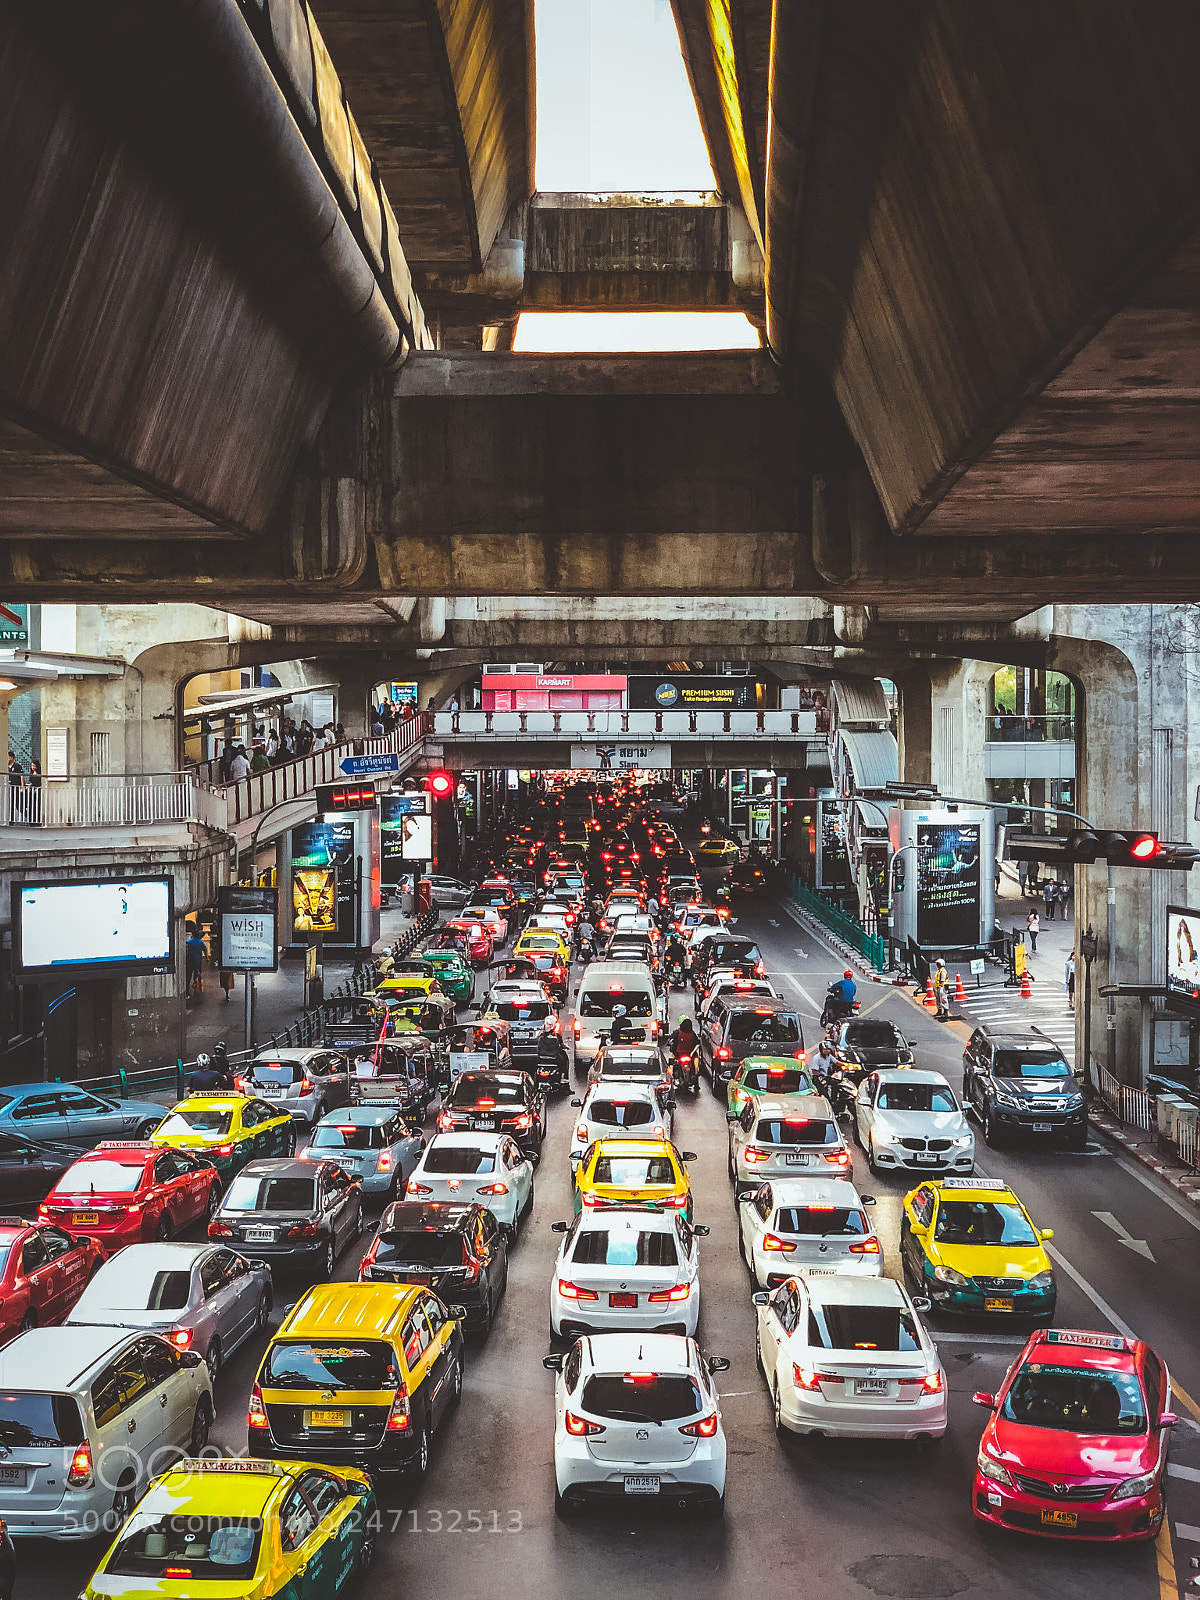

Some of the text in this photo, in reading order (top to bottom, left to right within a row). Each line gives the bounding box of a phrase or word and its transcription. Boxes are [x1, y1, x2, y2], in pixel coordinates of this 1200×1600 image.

[0, 631, 26, 640] NTS
[538, 678, 571, 686] KARMART
[681, 689, 715, 697] PREMIUM
[715, 689, 735, 697] SUSHI
[619, 747, 648, 758] สยาม
[1059, 1333, 1112, 1346] TAXI-METER
[196, 1461, 252, 1471] TAXI-METER
[1, 1470, 20, 1479] 1592
[641, 1477, 659, 1486] 2512
